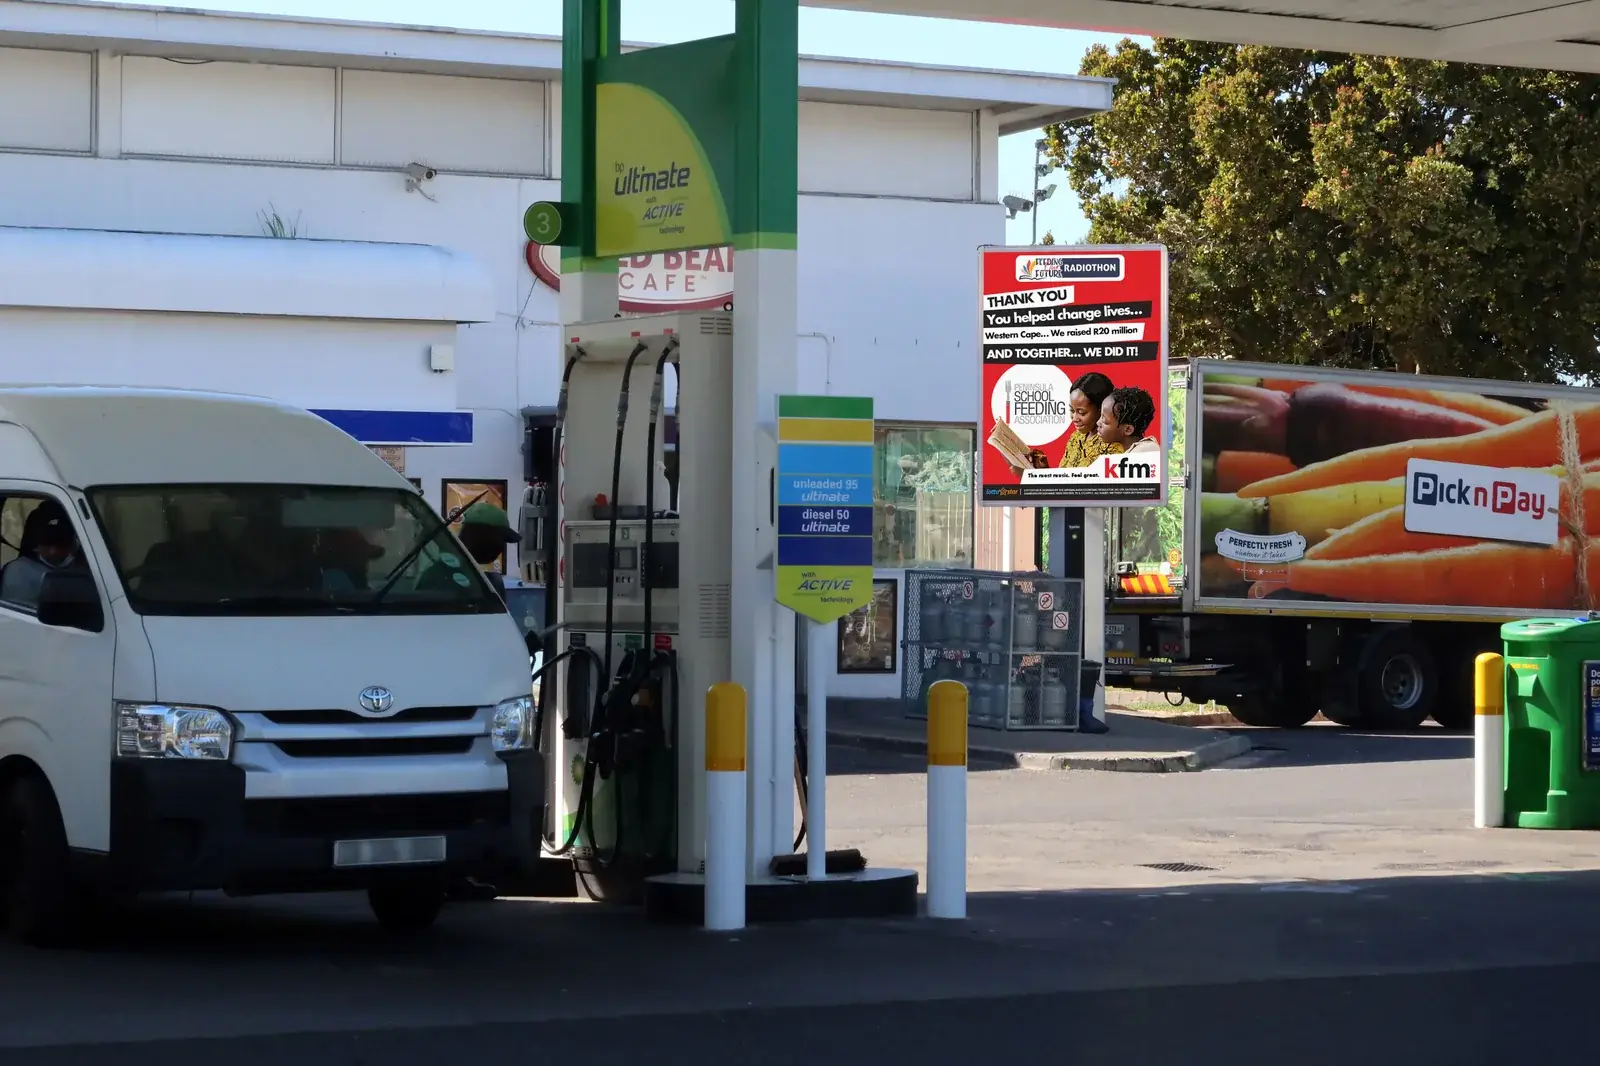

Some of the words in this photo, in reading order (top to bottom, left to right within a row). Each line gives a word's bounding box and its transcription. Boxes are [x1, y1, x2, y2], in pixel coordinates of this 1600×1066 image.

[614, 161, 624, 173] bp
[614, 160, 691, 196] ultimate
[642, 202, 685, 221] ACTIVE
[536, 212, 550, 234] 3
[1064, 264, 1116, 272] RADIOTHON
[619, 272, 696, 292] CAFE
[987, 292, 1034, 308] THANK
[1037, 290, 1067, 302] YOU
[986, 313, 1010, 326] You
[1014, 308, 1054, 326] helped
[1057, 308, 1102, 322] change
[1104, 305, 1142, 316] lives...
[985, 331, 1018, 340] Western
[1020, 330, 1049, 340] Cape...
[1050, 328, 1064, 337] We
[1066, 327, 1092, 336] raised
[1094, 328, 1110, 336] R20
[1112, 326, 1138, 334] million
[986, 348, 1012, 360] AND
[1014, 348, 1082, 358] TOGETHER...
[1084, 348, 1102, 357] WE
[1105, 346, 1124, 356] DID
[1126, 346, 1138, 356] IT!
[1014, 383, 1054, 391] PENINSULA
[1014, 390, 1054, 402] SCHOOL
[1014, 402, 1066, 416] FEEDING
[1014, 416, 1066, 424] ASSOCIATION
[1104, 458, 1150, 478] kfm
[793, 480, 843, 490] unleaded
[845, 480, 858, 490] 95
[801, 491, 850, 502] ultimate
[1412, 471, 1470, 506] Pick
[1473, 486, 1488, 507] n
[1492, 481, 1546, 520] Pay
[802, 510, 834, 520] diesel
[836, 510, 850, 520] 50
[801, 522, 850, 532] ultimate
[1228, 536, 1268, 550] PERFECTLY
[1269, 540, 1292, 550] FRESH
[1235, 549, 1260, 558] whatever
[1269, 550, 1286, 558] takes
[798, 580, 854, 591] ACTIVE
[820, 596, 854, 604] technology
